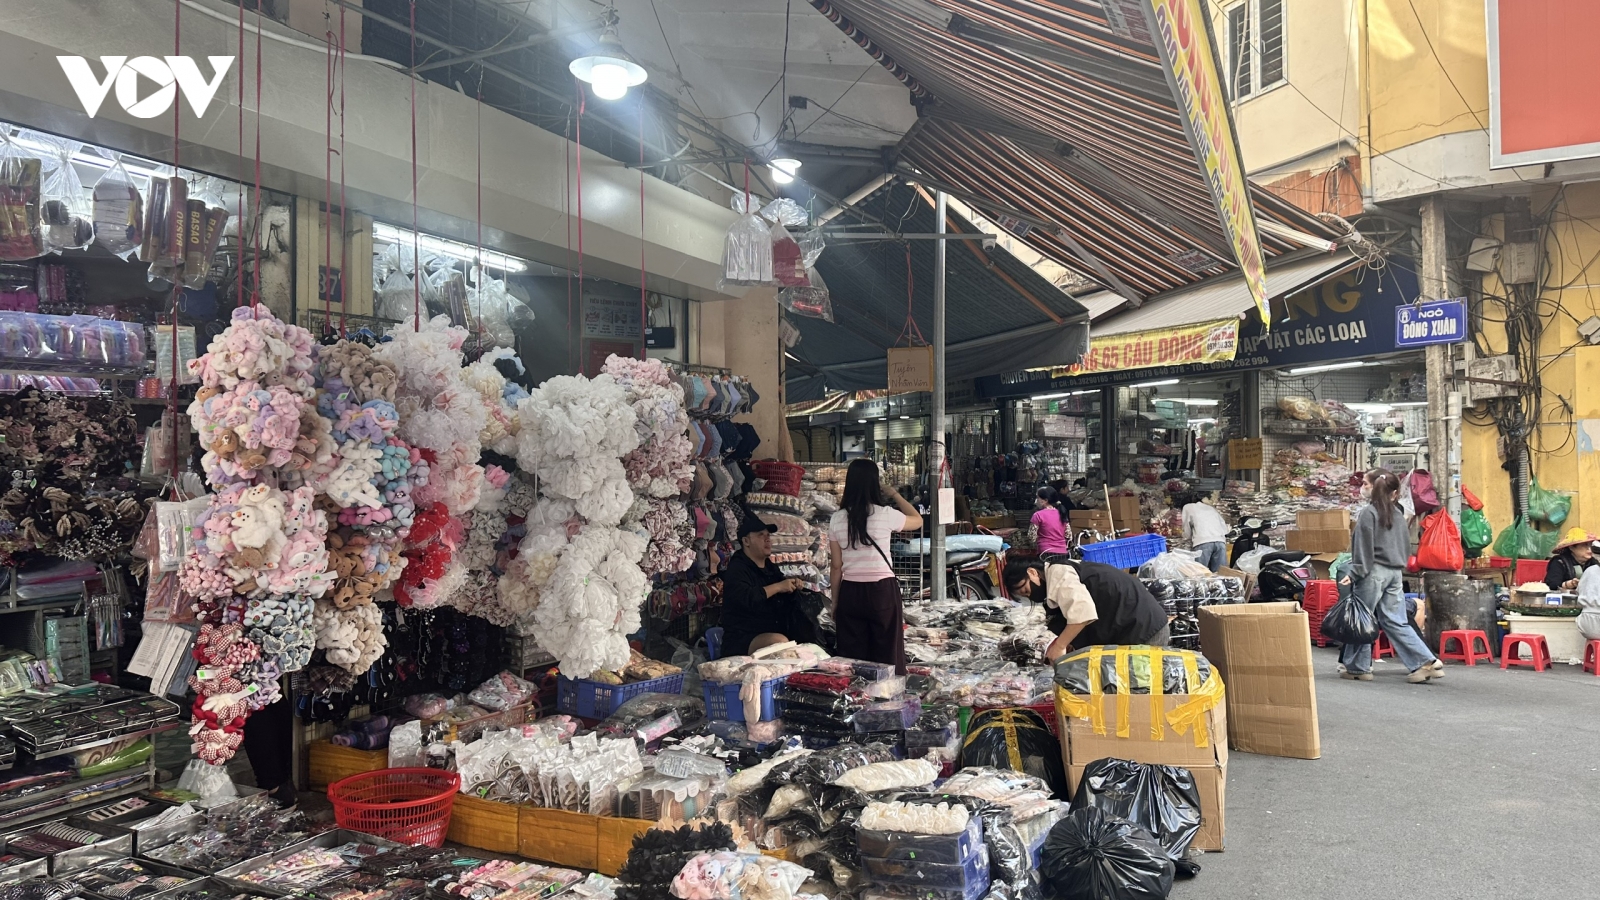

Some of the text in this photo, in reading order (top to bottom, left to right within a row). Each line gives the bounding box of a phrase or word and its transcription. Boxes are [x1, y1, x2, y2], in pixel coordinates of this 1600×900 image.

[191, 211, 200, 244] BASAO
[1294, 324, 1326, 346] CÁC
[1328, 320, 1367, 343] LOẠI
[1431, 317, 1456, 336] XUÂN
[1102, 346, 1118, 369] 65
[1234, 358, 1250, 368] 262
[1252, 356, 1269, 366] 994
[914, 378, 928, 387] Viên
